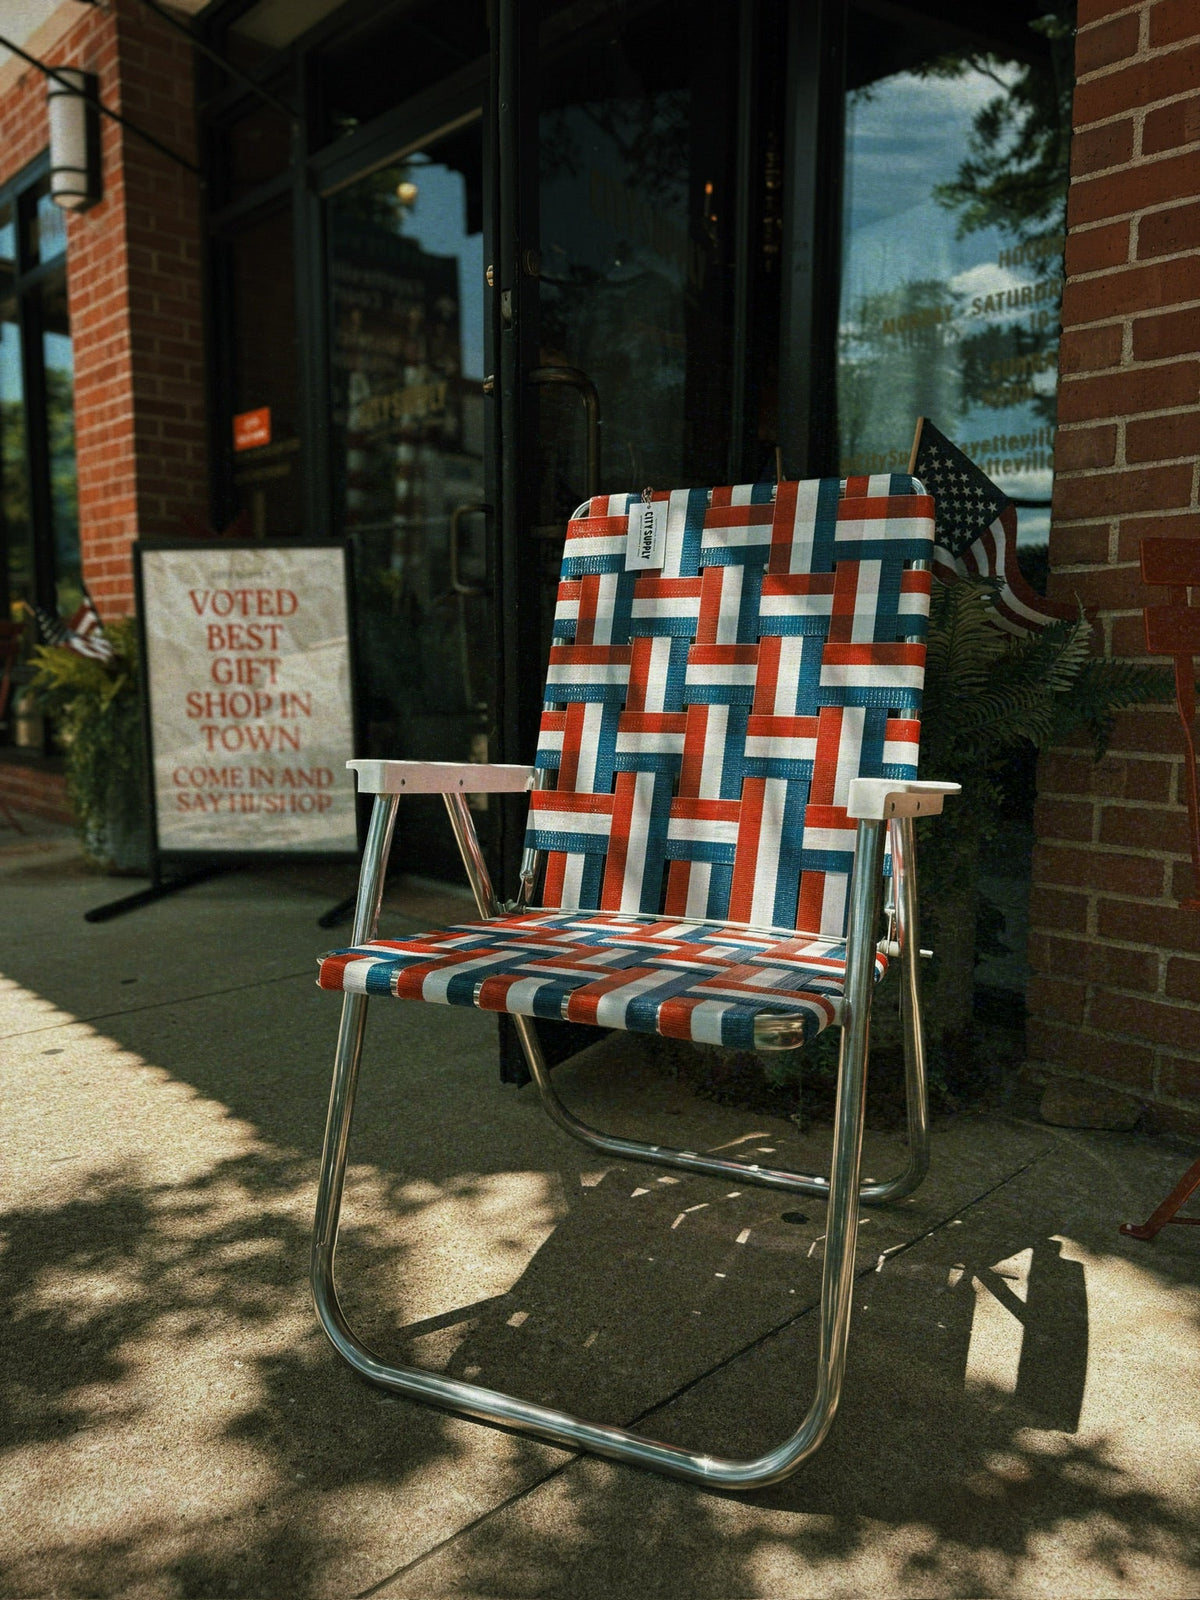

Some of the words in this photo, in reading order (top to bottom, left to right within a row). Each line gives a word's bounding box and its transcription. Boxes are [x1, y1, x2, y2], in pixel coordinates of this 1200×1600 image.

[972, 280, 1064, 315] SATURDA
[990, 351, 1058, 380] SUNDA
[188, 588, 299, 617] VOTED
[207, 623, 283, 651] BEST
[211, 657, 281, 686] GIFT
[185, 690, 273, 719] SHOP
[279, 691, 312, 719] IN
[201, 724, 301, 752] TOWN
[172, 765, 244, 788] COME
[249, 766, 274, 789] IN
[280, 766, 335, 789] AND
[176, 791, 222, 813] SAY
